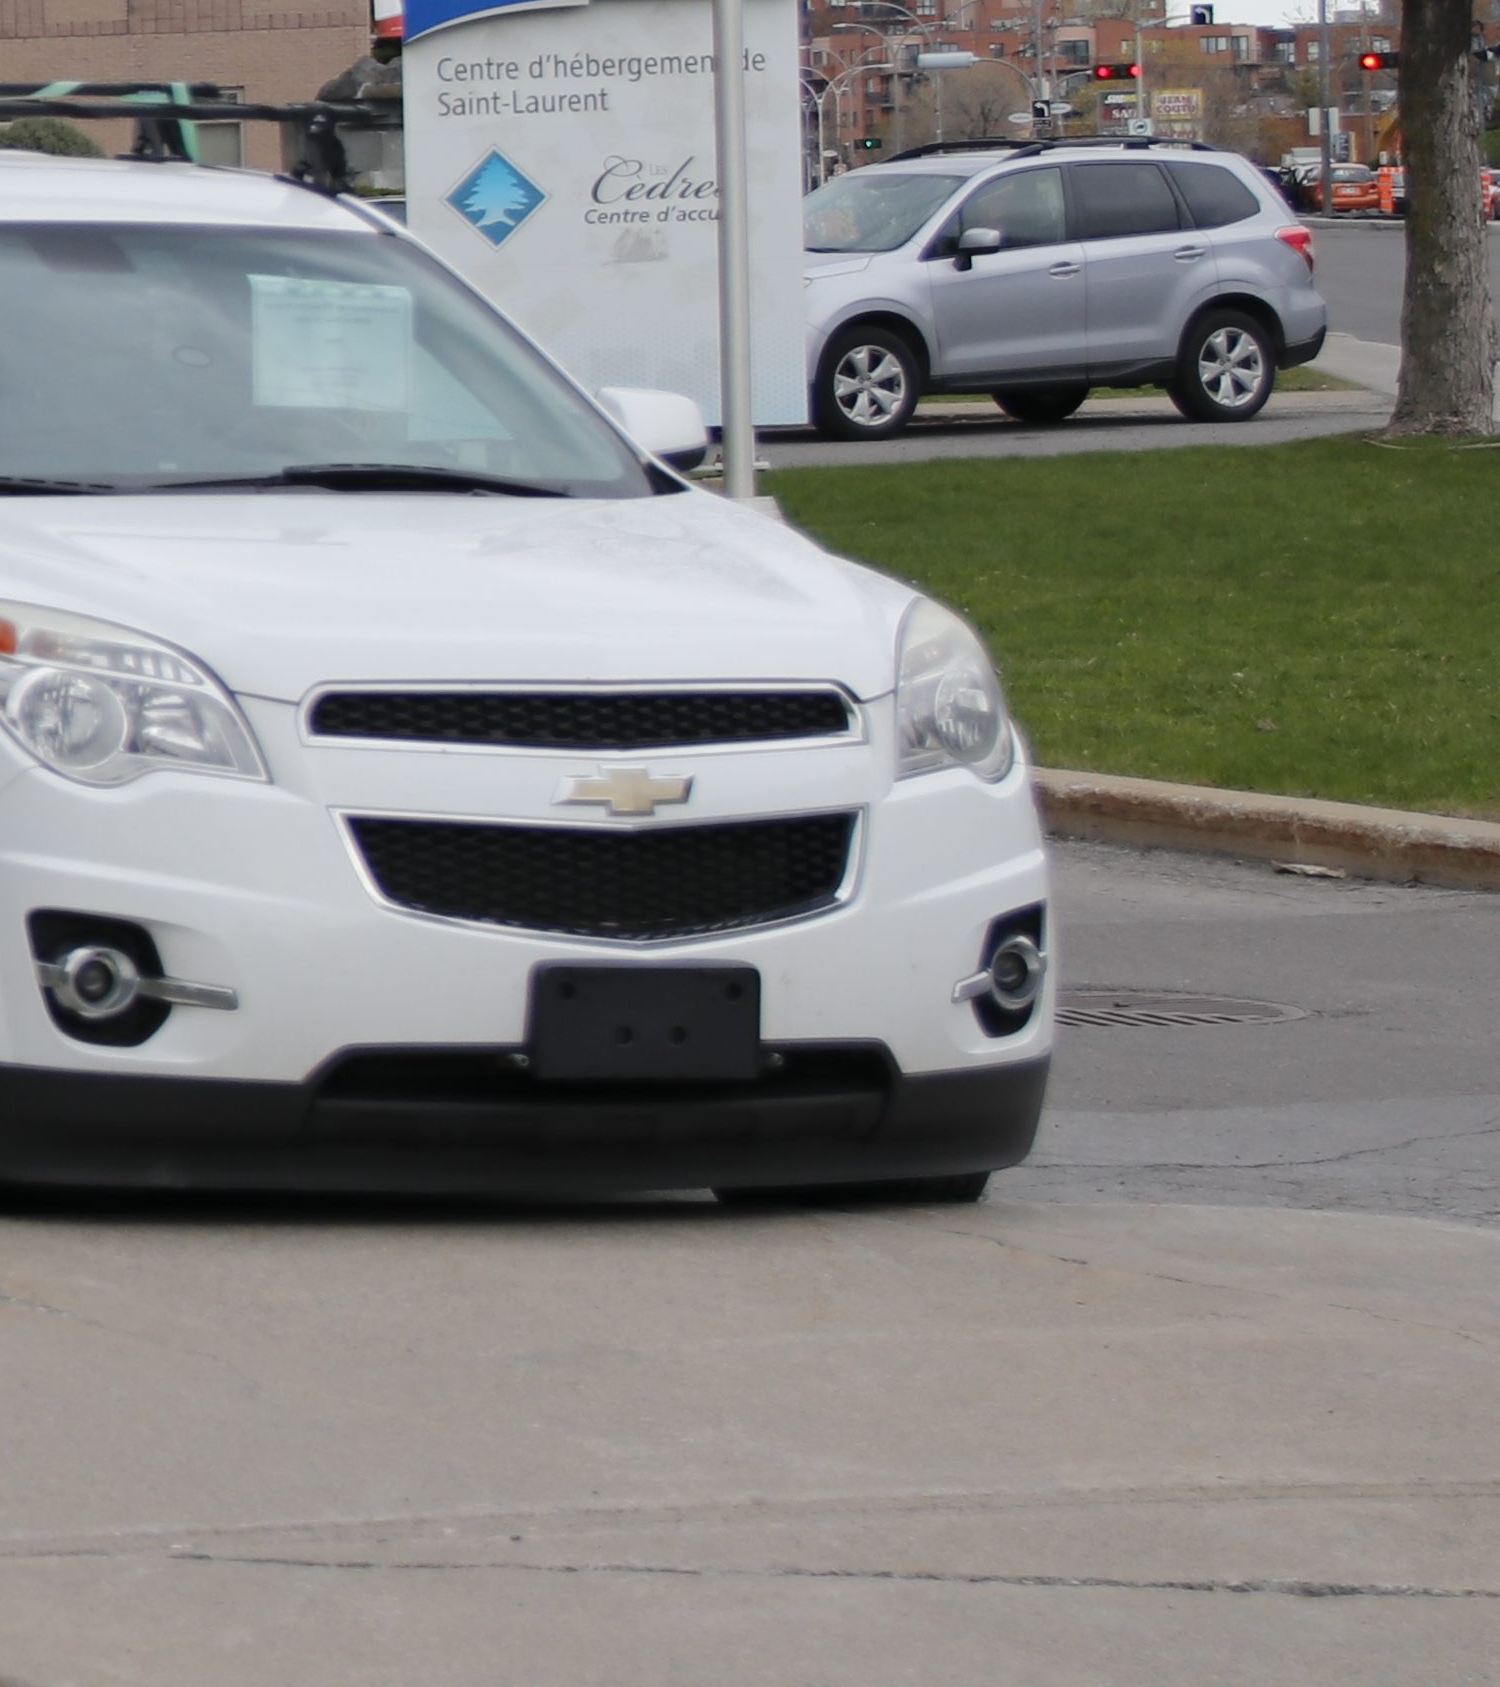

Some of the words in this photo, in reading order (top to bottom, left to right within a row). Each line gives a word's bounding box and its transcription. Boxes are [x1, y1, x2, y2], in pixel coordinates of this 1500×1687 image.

[437, 57, 519, 82] Centre
[528, 52, 717, 82] d'hébergemen
[438, 88, 610, 116] Saint-Laurent
[584, 209, 650, 224] Centre
